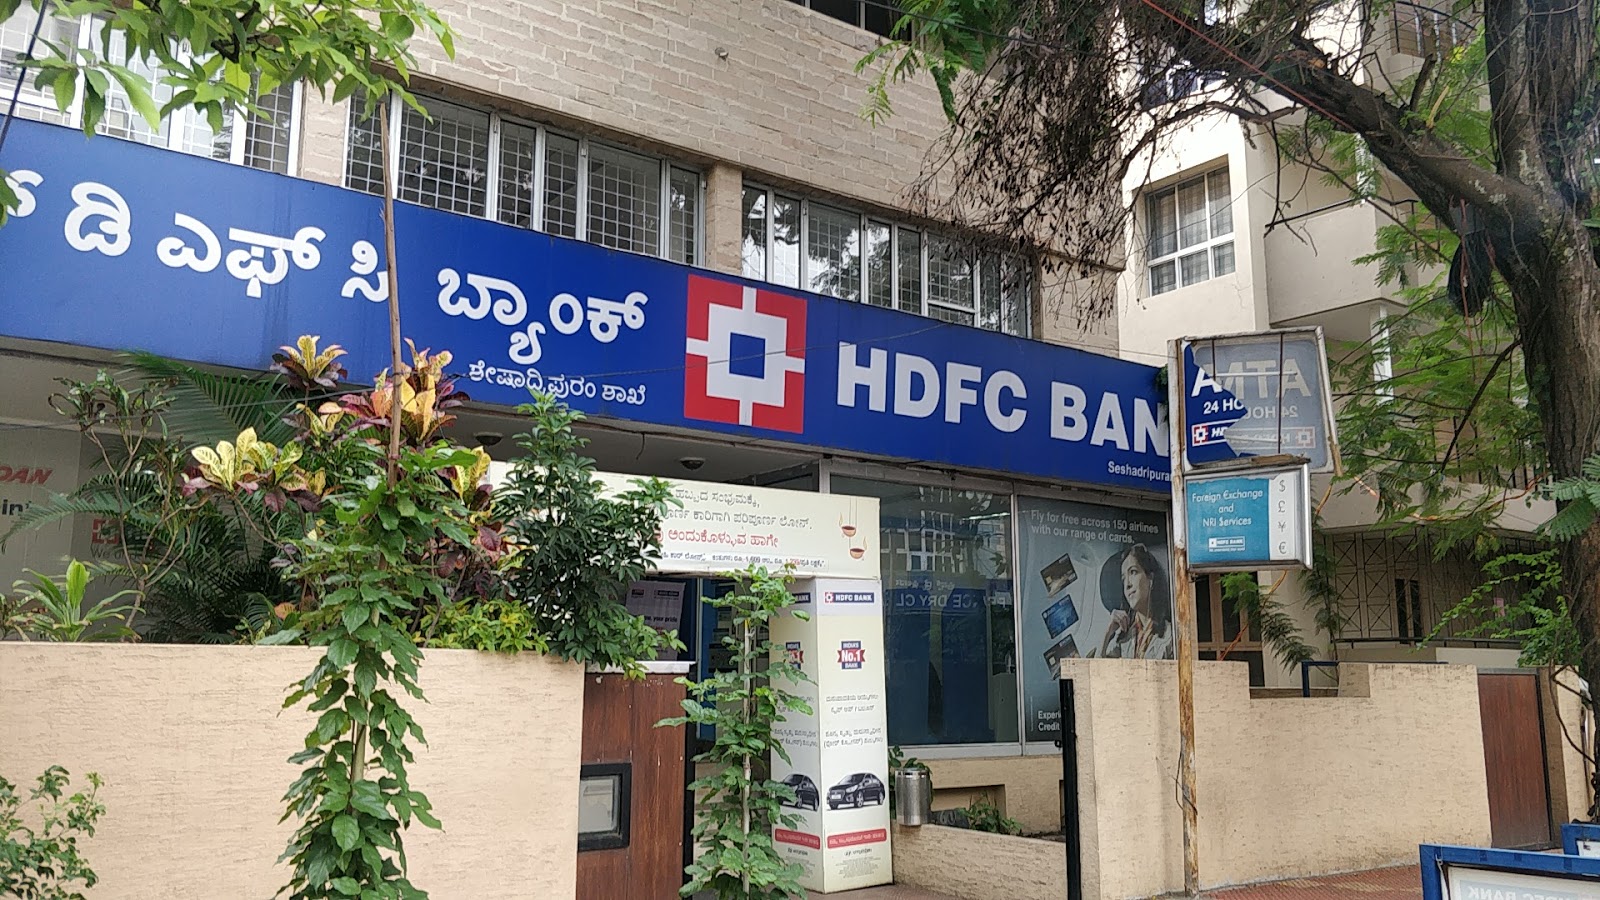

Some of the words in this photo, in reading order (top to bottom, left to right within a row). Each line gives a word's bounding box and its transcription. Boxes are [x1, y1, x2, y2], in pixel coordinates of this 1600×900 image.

[64, 181, 131, 257] ಡಿ
[156, 213, 327, 298] ಎಫ್
[341, 240, 390, 303] ಸಿ
[437, 266, 649, 364] ಬ್ಯಾಂಕ್
[601, 383, 647, 406] ಶಾಖೆ
[837, 341, 1028, 433] HDFC
[1050, 381, 1169, 457] BAN
[1203, 400, 1219, 415] 24
[1107, 460, 1170, 482] Seshadripura
[1192, 491, 1221, 503] Foreign
[1218, 504, 1234, 514] and
[1031, 510, 1045, 523] Fly
[1047, 512, 1059, 523] for
[1061, 513, 1079, 526] free
[1081, 517, 1110, 529] across
[1112, 519, 1128, 531] 150
[1129, 522, 1159, 534] airlines
[1202, 517, 1217, 528] NRI
[1031, 523, 1051, 536] with
[1053, 527, 1069, 537] our
[1070, 529, 1096, 541] range
[1097, 530, 1107, 541] of
[1108, 533, 1135, 544] cards.
[841, 650, 861, 662] No.1
[1038, 721, 1060, 731] Credit
